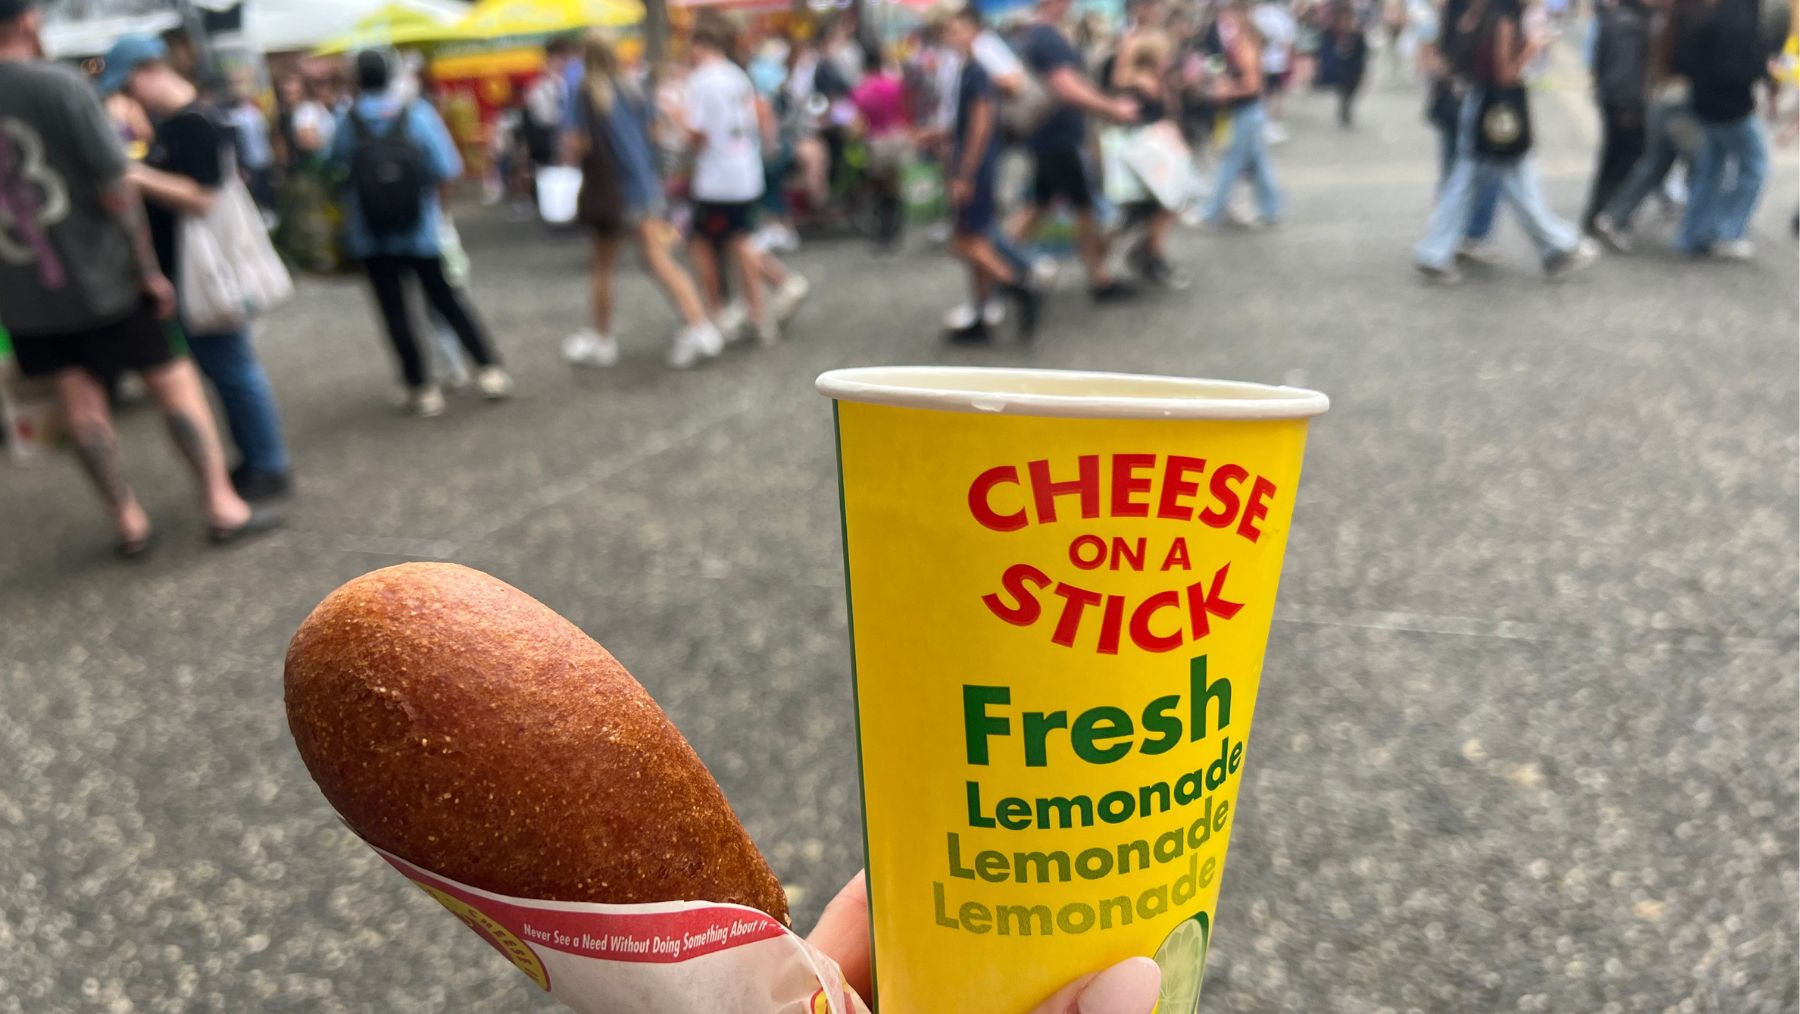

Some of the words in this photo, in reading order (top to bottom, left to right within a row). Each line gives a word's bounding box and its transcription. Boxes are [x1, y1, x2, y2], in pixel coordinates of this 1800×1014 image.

[968, 454, 1277, 544] CHEESE
[1069, 534, 1147, 571] ON
[1160, 537, 1192, 571] A
[981, 561, 1246, 655] STICK
[963, 655, 1232, 767] Fresh
[966, 737, 1243, 830] Lemonade
[947, 796, 1229, 883] Lemonade
[523, 923, 551, 941] Never
[554, 930, 570, 946] See
[573, 938, 579, 947] a
[582, 934, 608, 950] Need
[610, 935, 650, 953] Without
[652, 936, 681, 957] Doing
[683, 925, 728, 951] Something
[730, 920, 757, 937] About
[933, 853, 1216, 936] Lemonade
